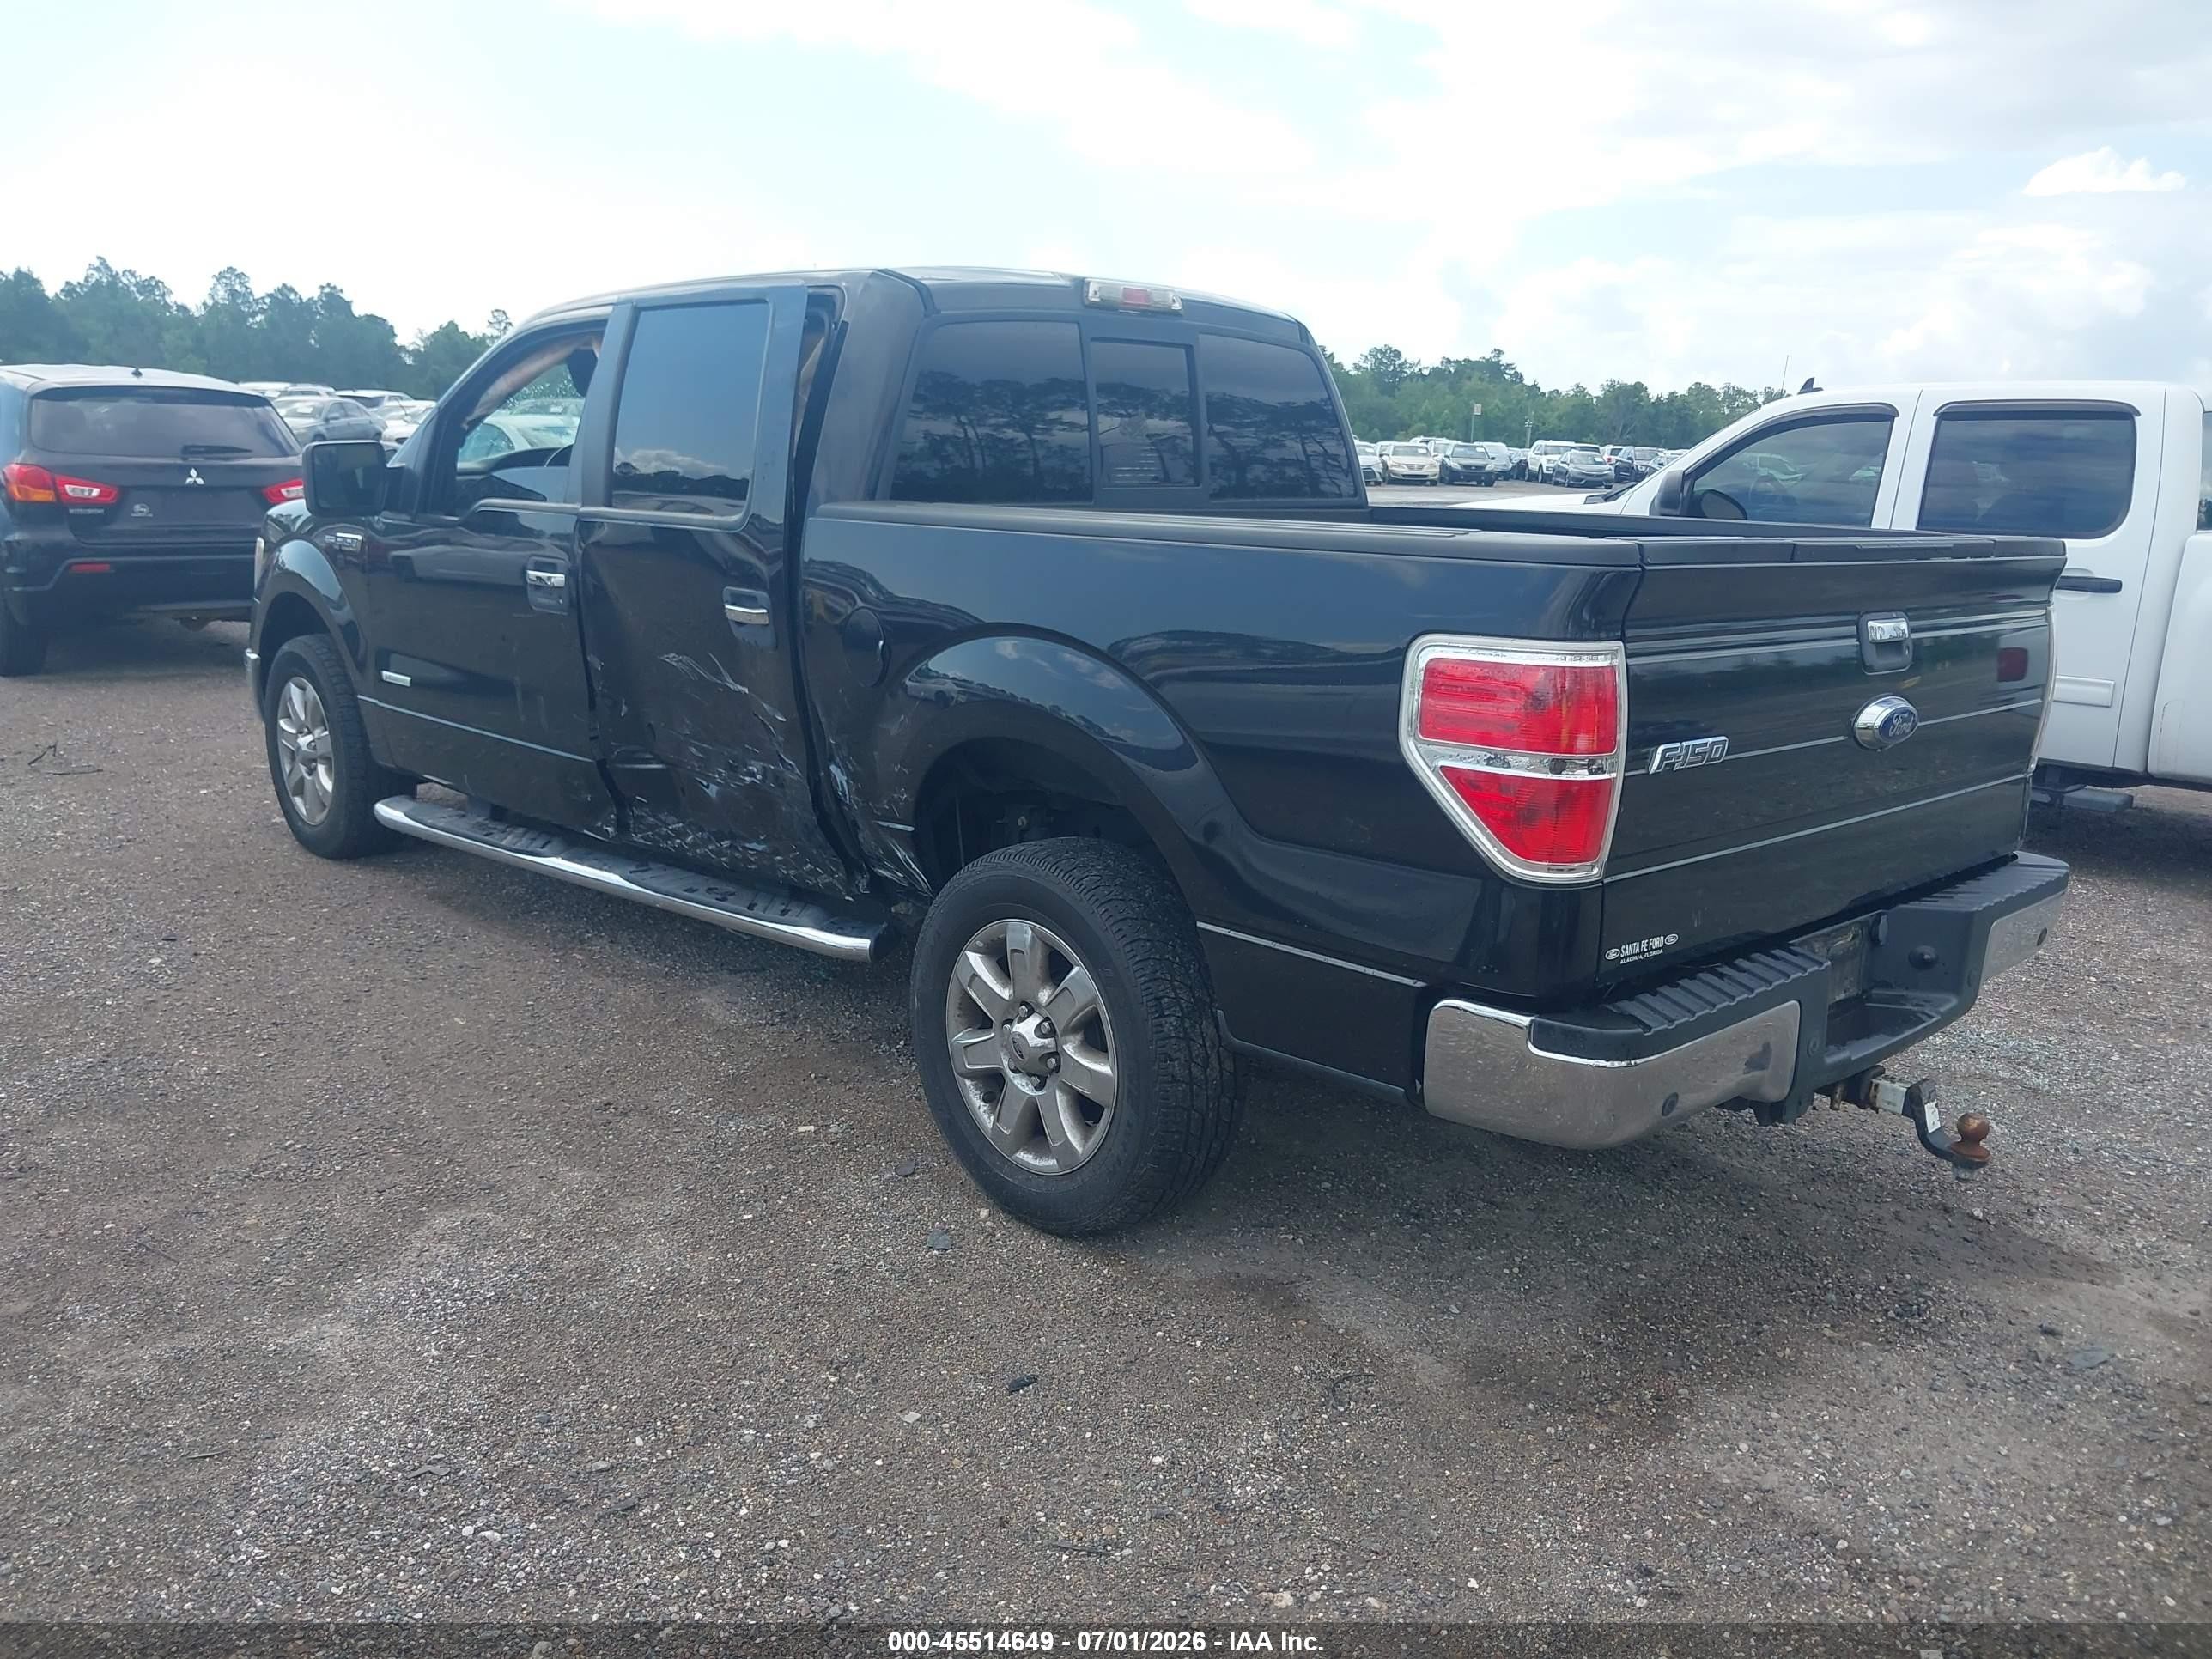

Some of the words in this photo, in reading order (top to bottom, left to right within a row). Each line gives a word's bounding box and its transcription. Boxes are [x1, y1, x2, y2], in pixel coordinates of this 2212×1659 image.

[1888, 713, 1914, 737] Ford
[1620, 942, 1640, 957] SANTA
[1641, 939, 1649, 951] FE
[1649, 936, 1664, 950] FORD
[1644, 949, 1663, 958] FLORIDA
